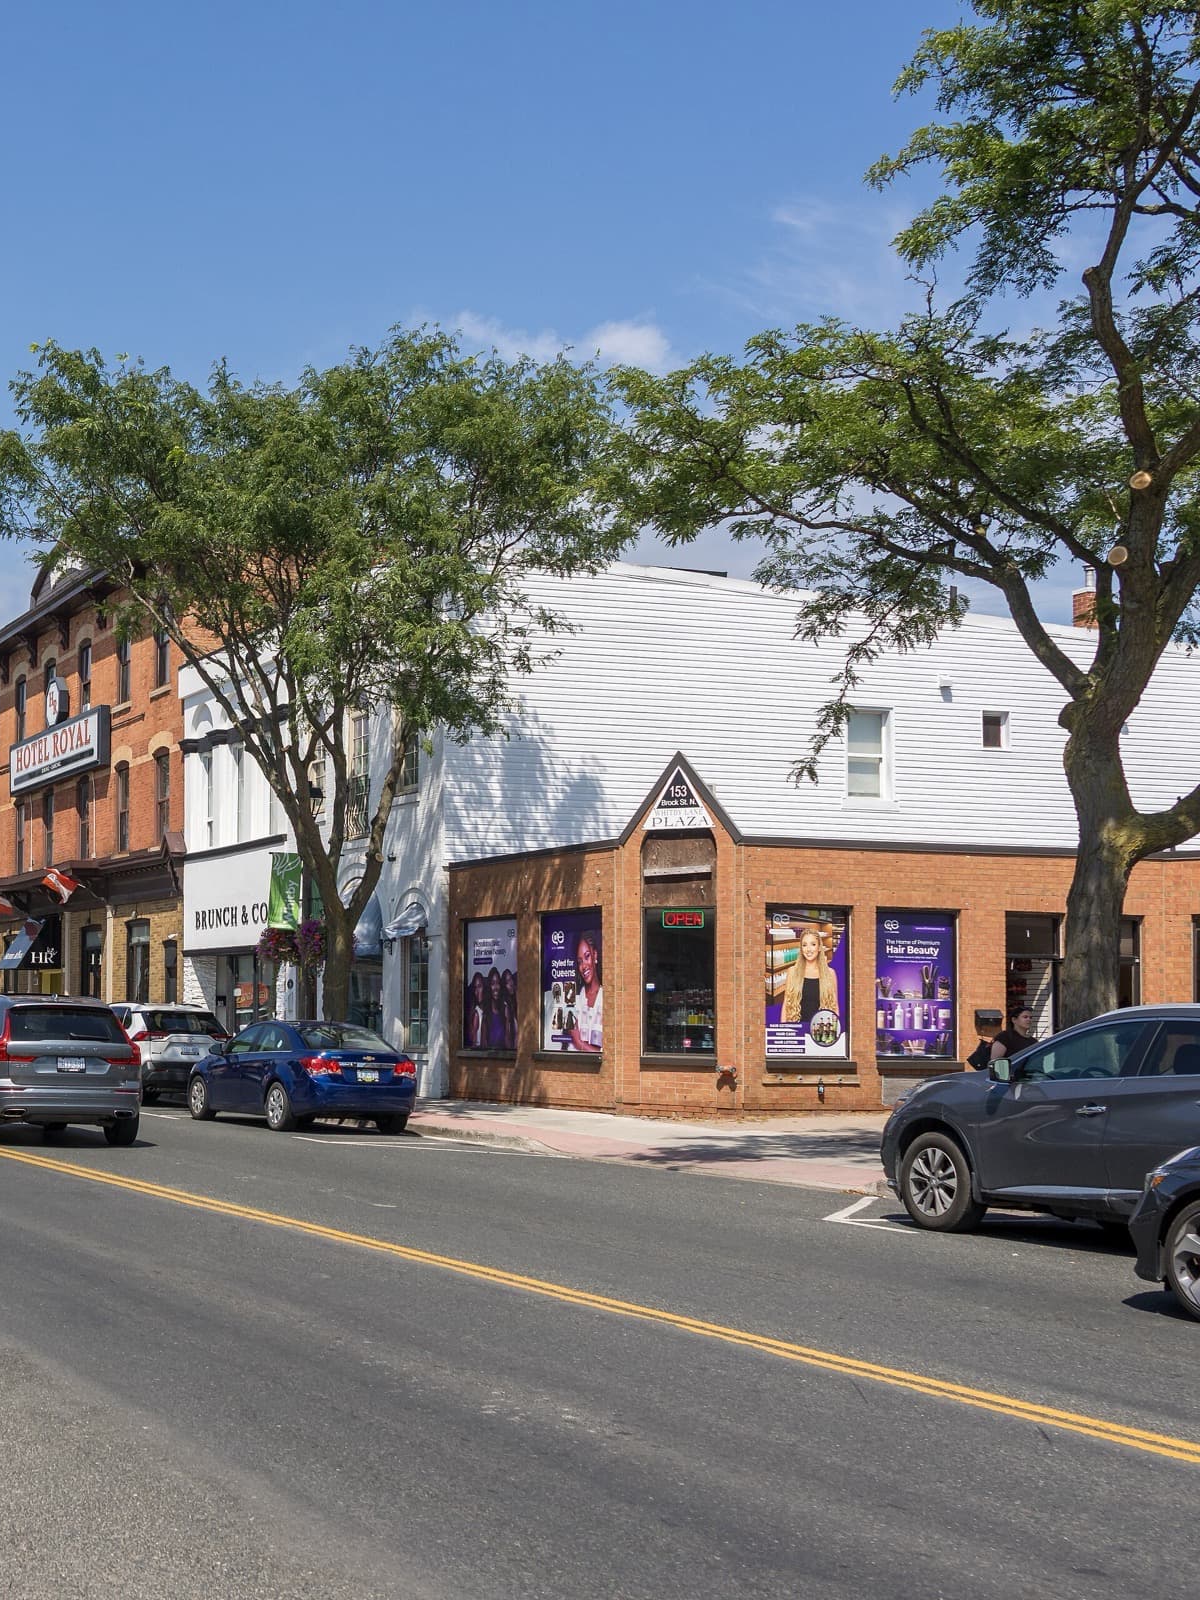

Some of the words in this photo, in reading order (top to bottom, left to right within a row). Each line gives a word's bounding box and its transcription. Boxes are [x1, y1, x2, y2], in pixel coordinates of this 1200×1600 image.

[16, 737, 50, 772] HOTEL
[53, 718, 91, 758] ROYAL
[669, 785, 688, 797] 153
[652, 816, 709, 827] PLAZA
[195, 906, 238, 931] BRUNCH
[241, 905, 249, 926] &
[251, 902, 268, 924] CO
[665, 912, 702, 926] OPEN
[30, 950, 55, 963] HR
[886, 945, 906, 954] Hair
[907, 945, 940, 956] Beauty
[551, 959, 566, 967] Styled
[566, 958, 575, 966] for
[551, 968, 576, 979] Queens
